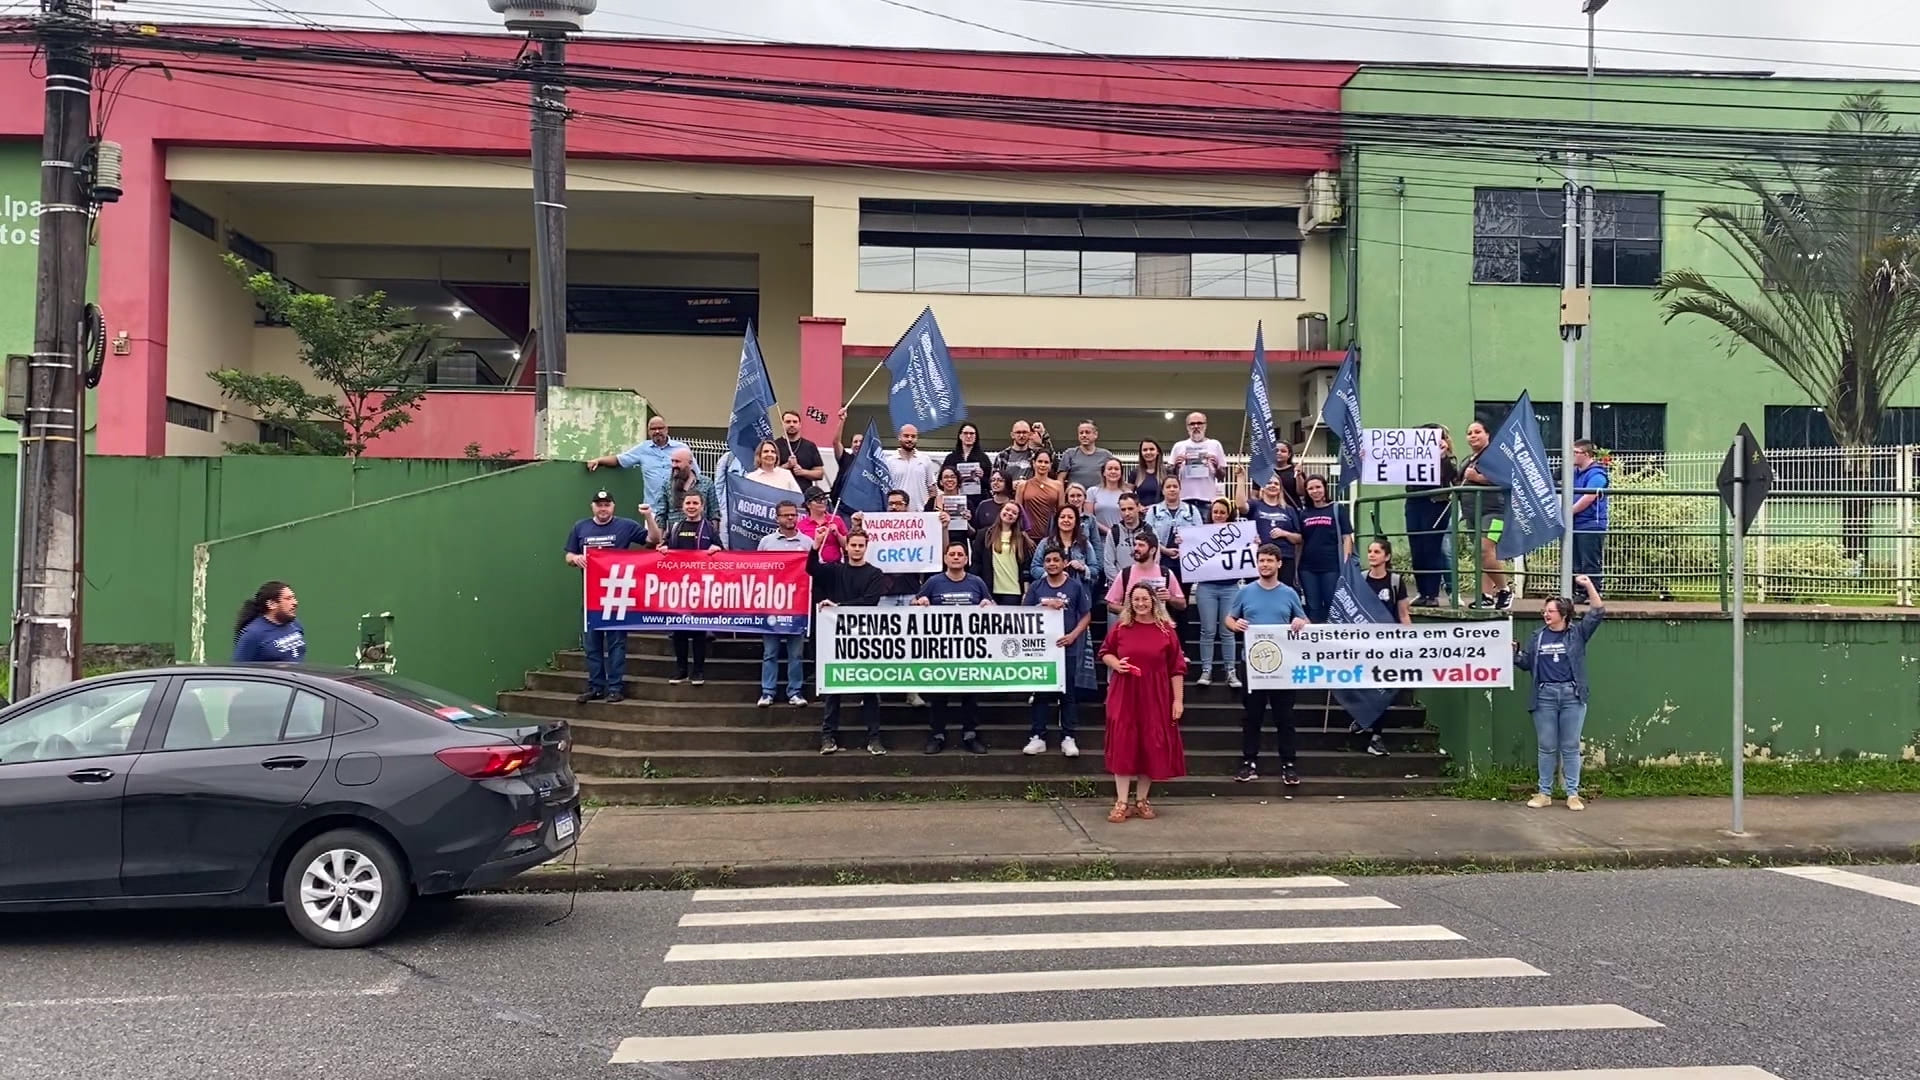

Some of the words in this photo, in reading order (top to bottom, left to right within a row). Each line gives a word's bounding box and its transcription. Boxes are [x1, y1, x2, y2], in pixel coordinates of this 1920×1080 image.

[0, 195, 40, 222] lpa
[1372, 430, 1405, 446] PISO
[1415, 430, 1437, 446] NA
[1372, 447, 1432, 460] CARREIRA
[1378, 460, 1388, 482] É
[738, 500, 766, 518] AGORA
[881, 530, 926, 542] CARREIRA
[1182, 524, 1241, 572] CONCURSO
[1221, 543, 1256, 570] JÁ
[656, 562, 678, 571] FAÇA
[680, 562, 706, 570] PARTE
[708, 562, 734, 570] DESSE
[736, 562, 784, 570] MOVIMENTO
[642, 615, 764, 626] www.profetemvalor.com.br
[836, 614, 900, 636] APENAS
[907, 614, 918, 636] A
[924, 614, 964, 636] LUTA
[968, 612, 1044, 635] GARANTE
[1022, 638, 1046, 648] SINTE
[1287, 628, 1370, 643] Magistério
[1376, 629, 1417, 640] entra
[1424, 630, 1447, 640] em
[1453, 627, 1500, 638] Greve
[836, 637, 907, 660] NOSSOS
[912, 637, 992, 659] DIREITOS.
[1302, 651, 1311, 660] a
[1316, 648, 1360, 662] partir
[1366, 648, 1384, 660] do
[1390, 647, 1413, 659] dia
[1418, 646, 1486, 658] 23/04/24
[832, 667, 915, 682] NEGOCIA
[919, 666, 1048, 682] GOVERNADOR!
[1292, 664, 1364, 684] #Prof
[1372, 668, 1422, 682] tem
[1432, 664, 1502, 682] valor
